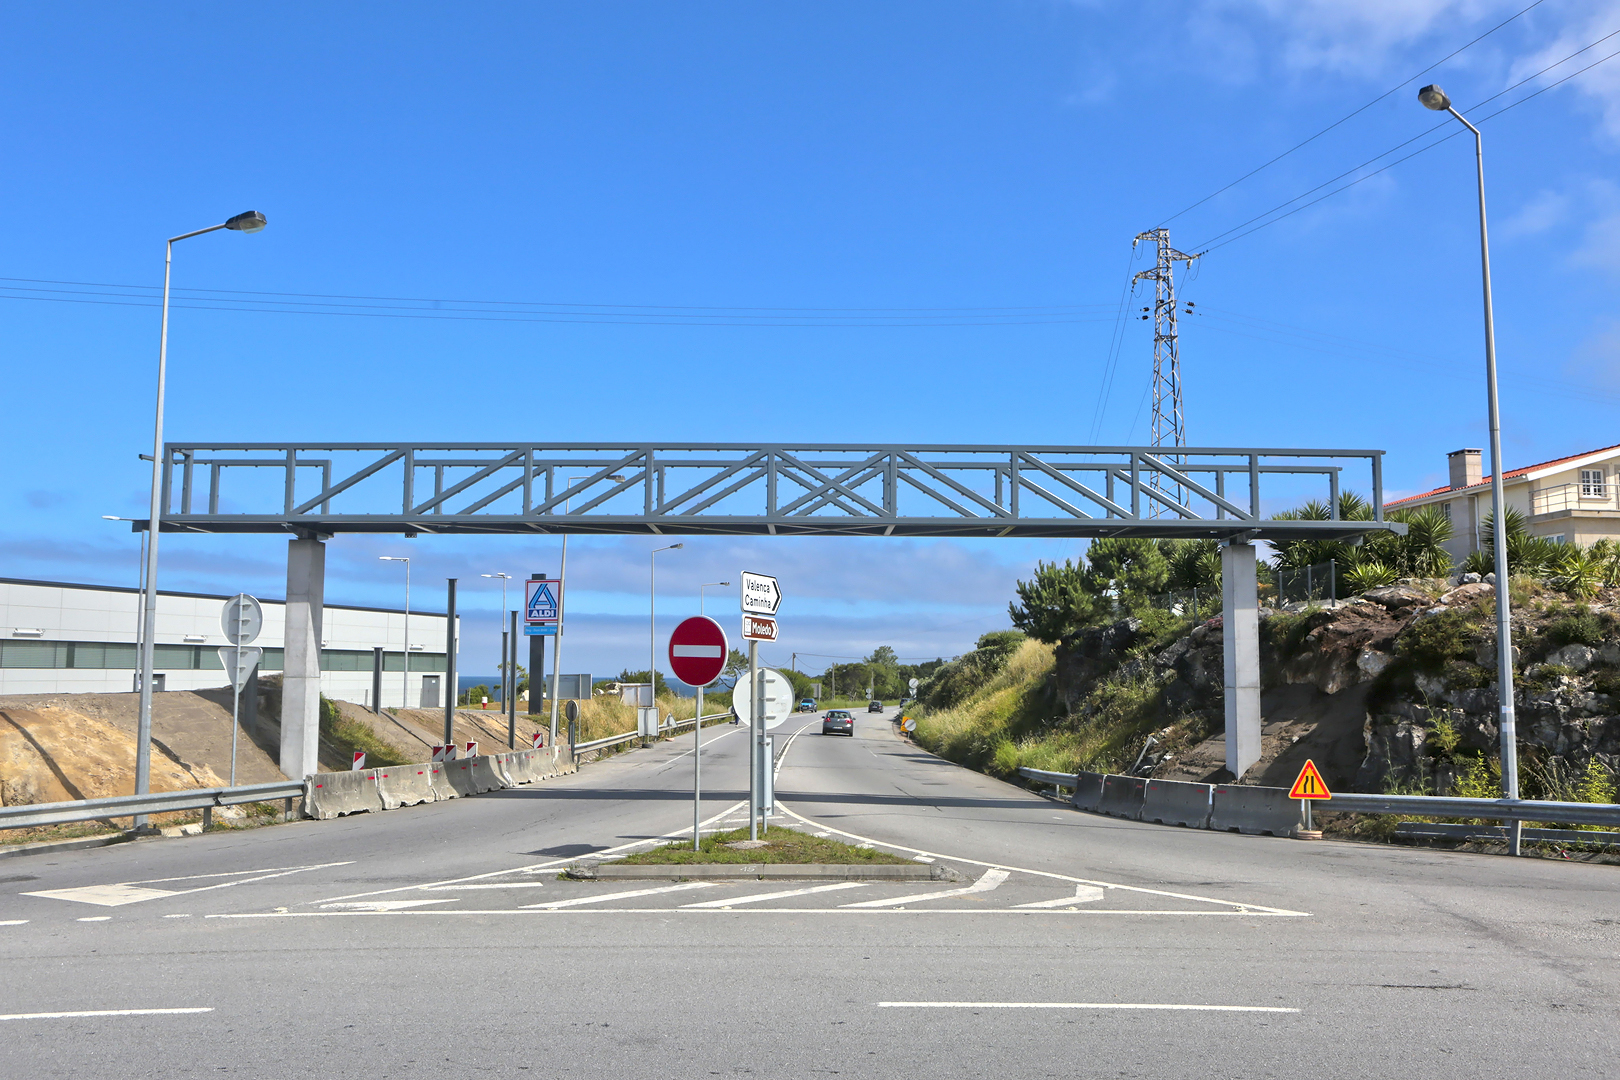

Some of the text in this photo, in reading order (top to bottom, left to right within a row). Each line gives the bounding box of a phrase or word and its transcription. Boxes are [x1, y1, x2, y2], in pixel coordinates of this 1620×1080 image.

[745, 593, 771, 609] Caminha
[531, 609, 554, 617] ALDI
[751, 621, 771, 635] Moledo
